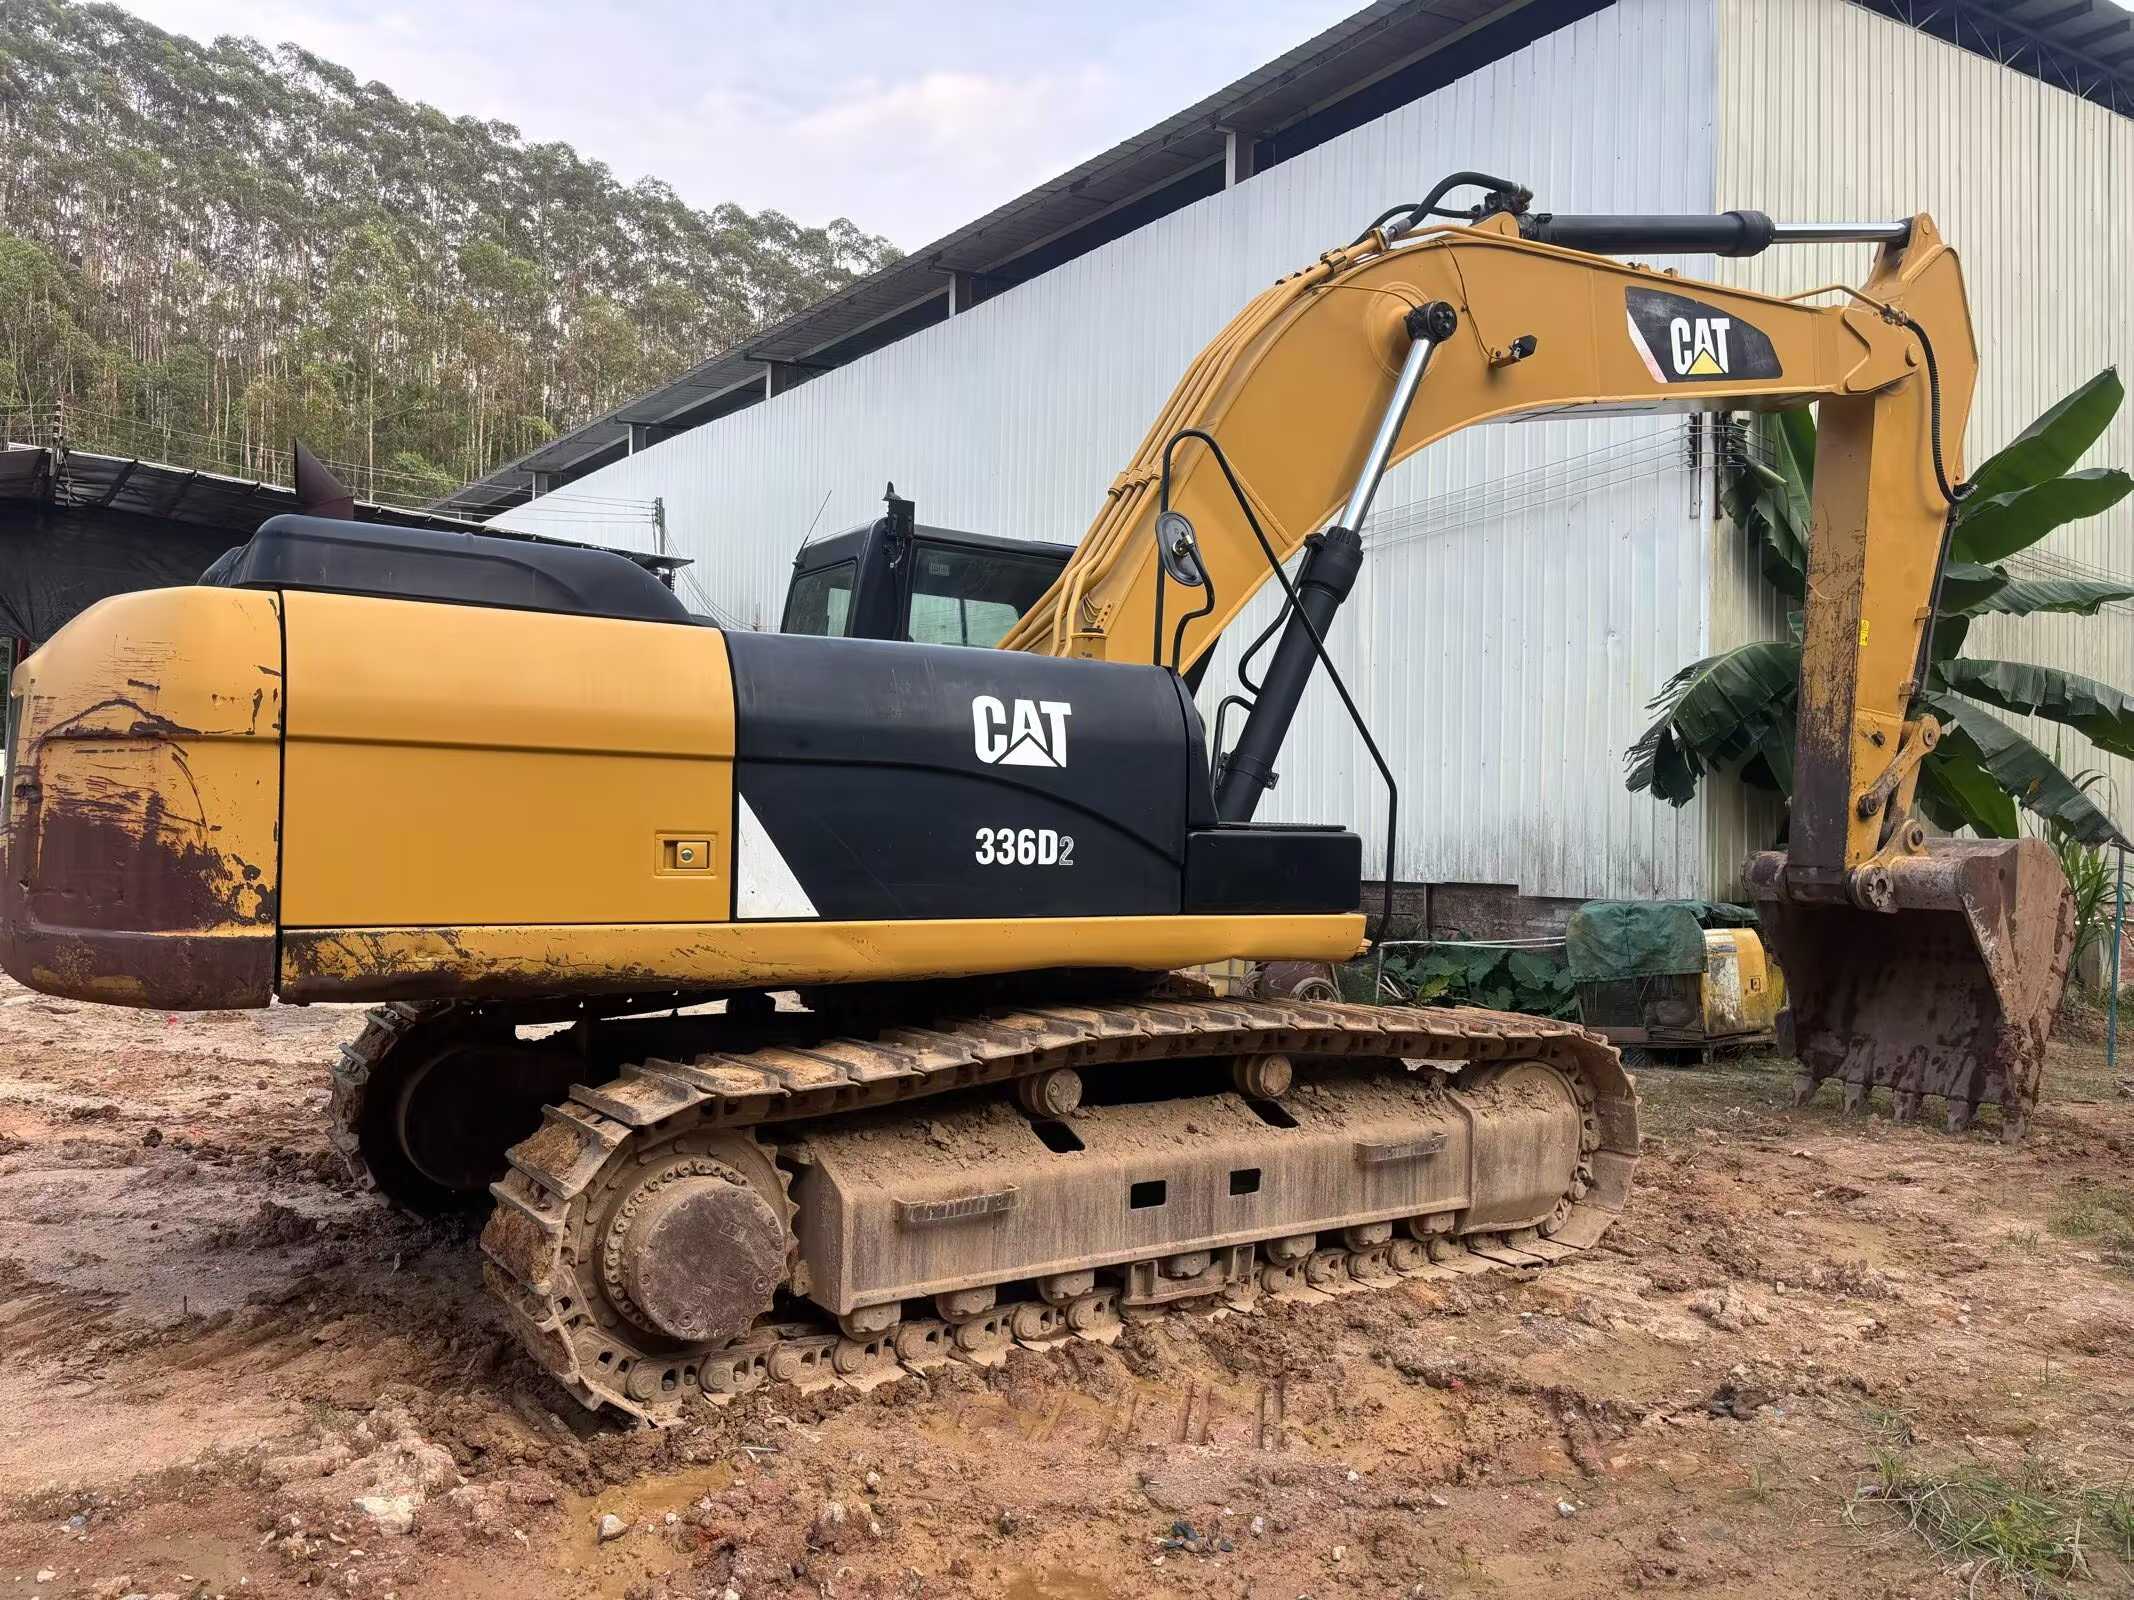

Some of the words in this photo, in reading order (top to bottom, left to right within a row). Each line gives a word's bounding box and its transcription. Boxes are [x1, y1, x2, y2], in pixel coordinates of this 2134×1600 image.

[1670, 317, 1730, 375] CAT
[972, 695, 1072, 768] CAT
[975, 827, 1074, 866] 336D2
